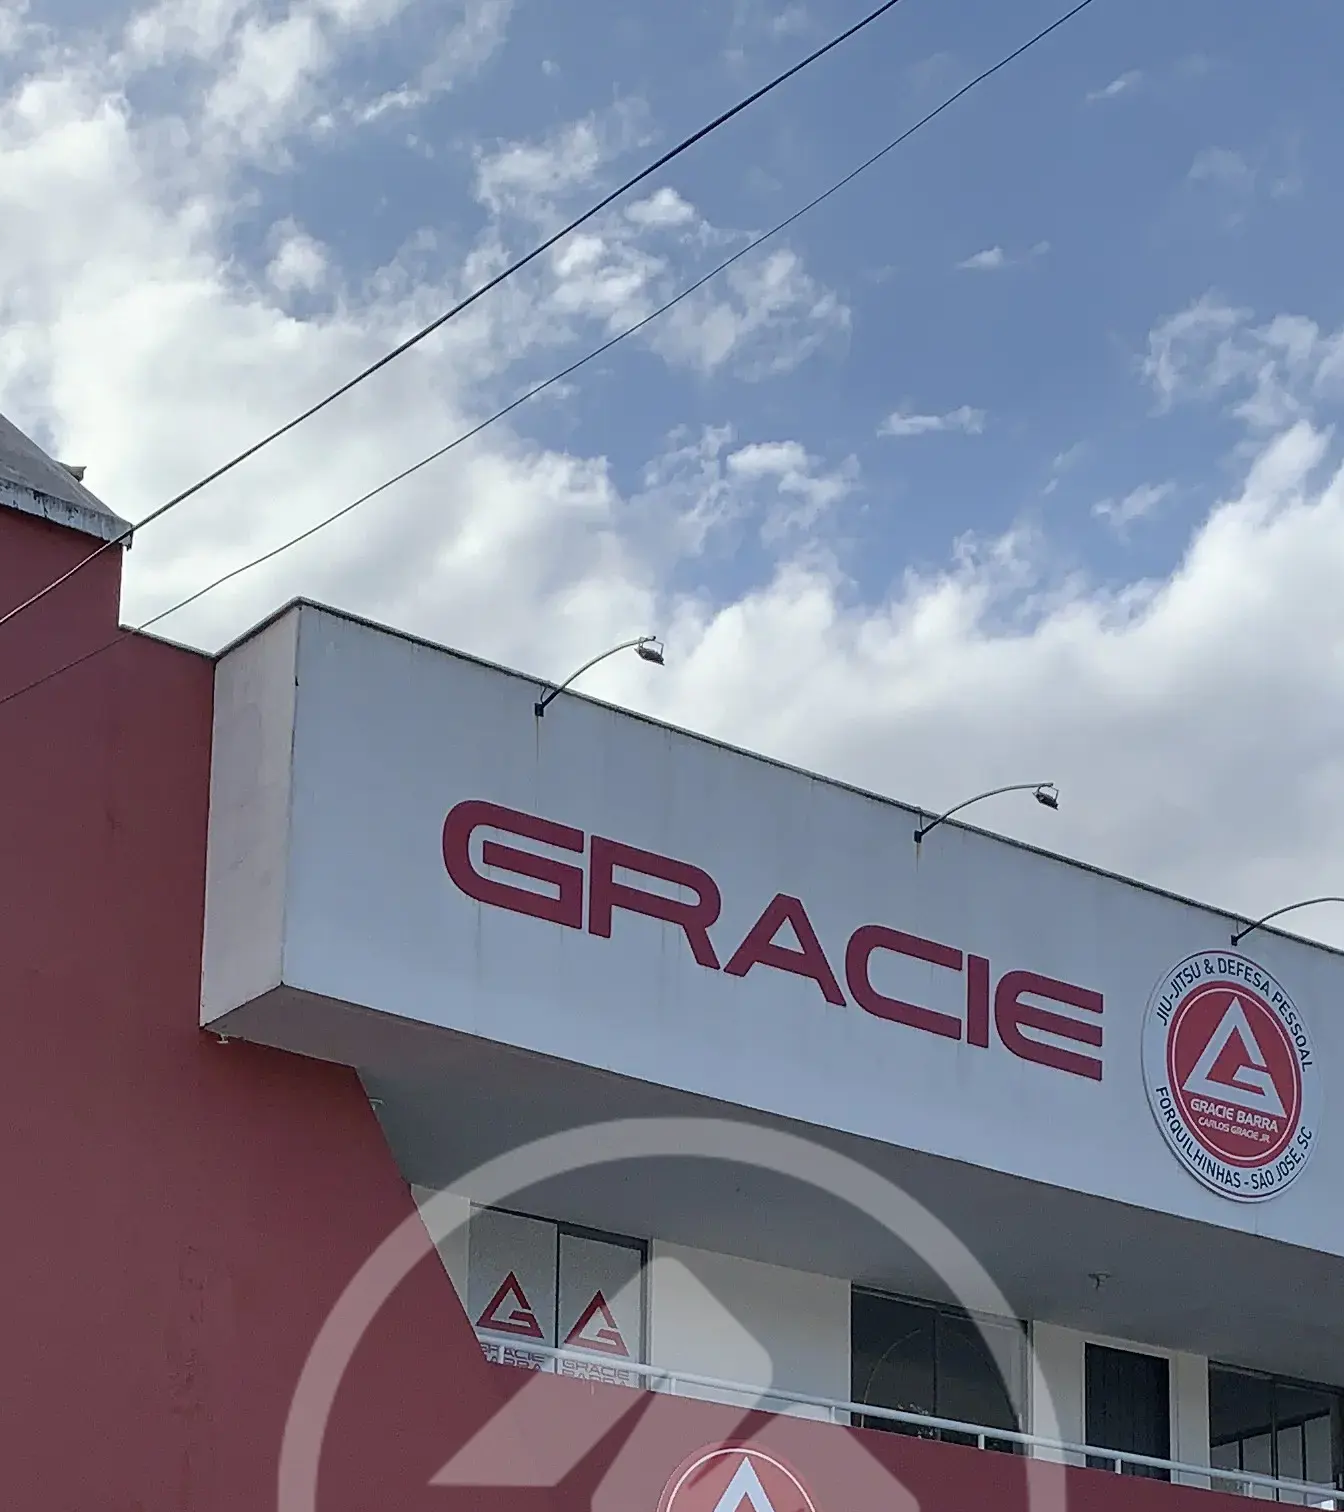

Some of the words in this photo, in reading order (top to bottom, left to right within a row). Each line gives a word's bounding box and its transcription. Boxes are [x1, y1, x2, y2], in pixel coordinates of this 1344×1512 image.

[442, 800, 1104, 1081] GRACIE
[1156, 961, 1201, 1026] JIU-JITSU
[1203, 957, 1215, 975] &
[1217, 957, 1270, 997] DEFESA
[1272, 991, 1314, 1073] PESSOAL
[1156, 1086, 1242, 1189] FORQUILHINHAS
[1251, 1168, 1275, 1190] SÃO
[1297, 1126, 1313, 1151] SC
[1190, 1098, 1234, 1121] GRACIE
[1237, 1106, 1279, 1132] BARRA
[1198, 1116, 1230, 1134] CARLOS
[1230, 1125, 1259, 1141] GRACIE
[562, 1358, 630, 1379] GRACIE
